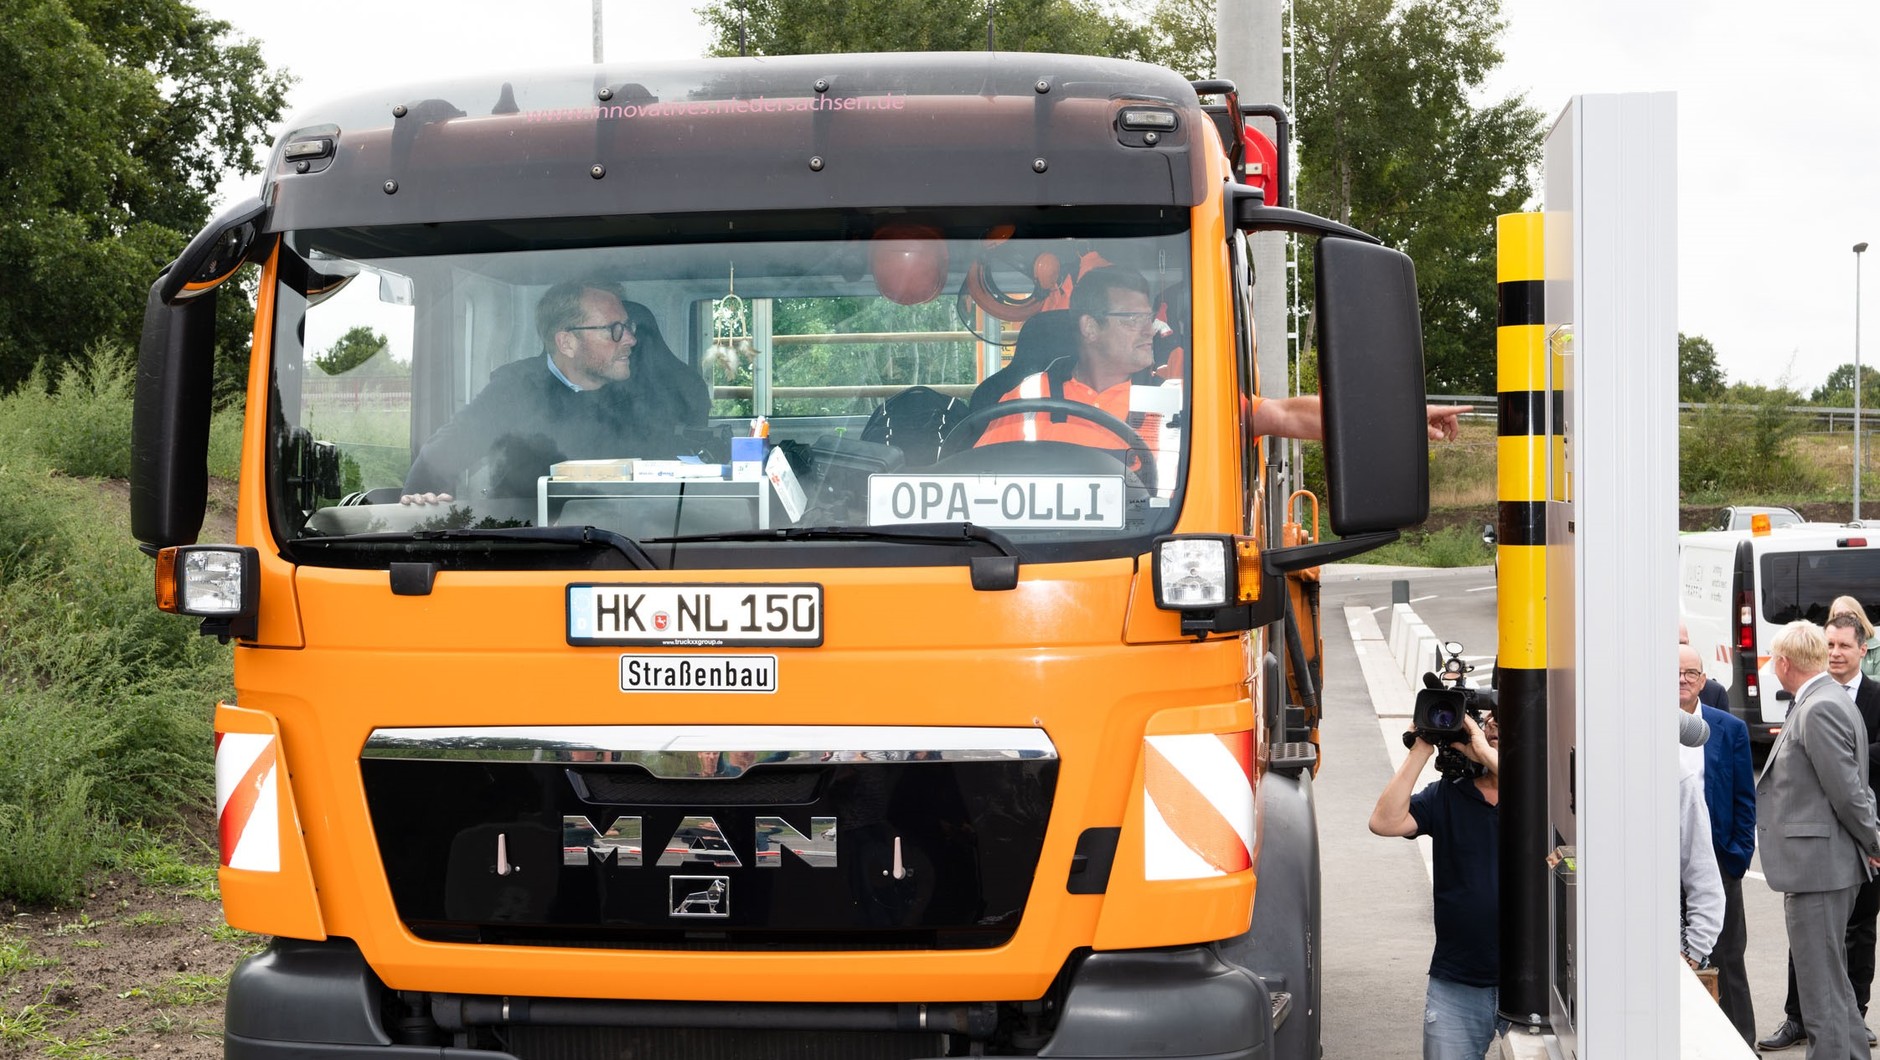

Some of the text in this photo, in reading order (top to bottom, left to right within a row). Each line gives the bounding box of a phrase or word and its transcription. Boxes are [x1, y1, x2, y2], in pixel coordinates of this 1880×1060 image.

[526, 93, 904, 122] www.innovatives.niedersachsen.de
[891, 482, 1104, 520] OPA-OLLI
[596, 594, 815, 632] HK NL 150
[662, 638, 723, 646] www.truckxxgroup.de
[628, 660, 768, 687] Straßenbau
[563, 815, 838, 867] MAN
